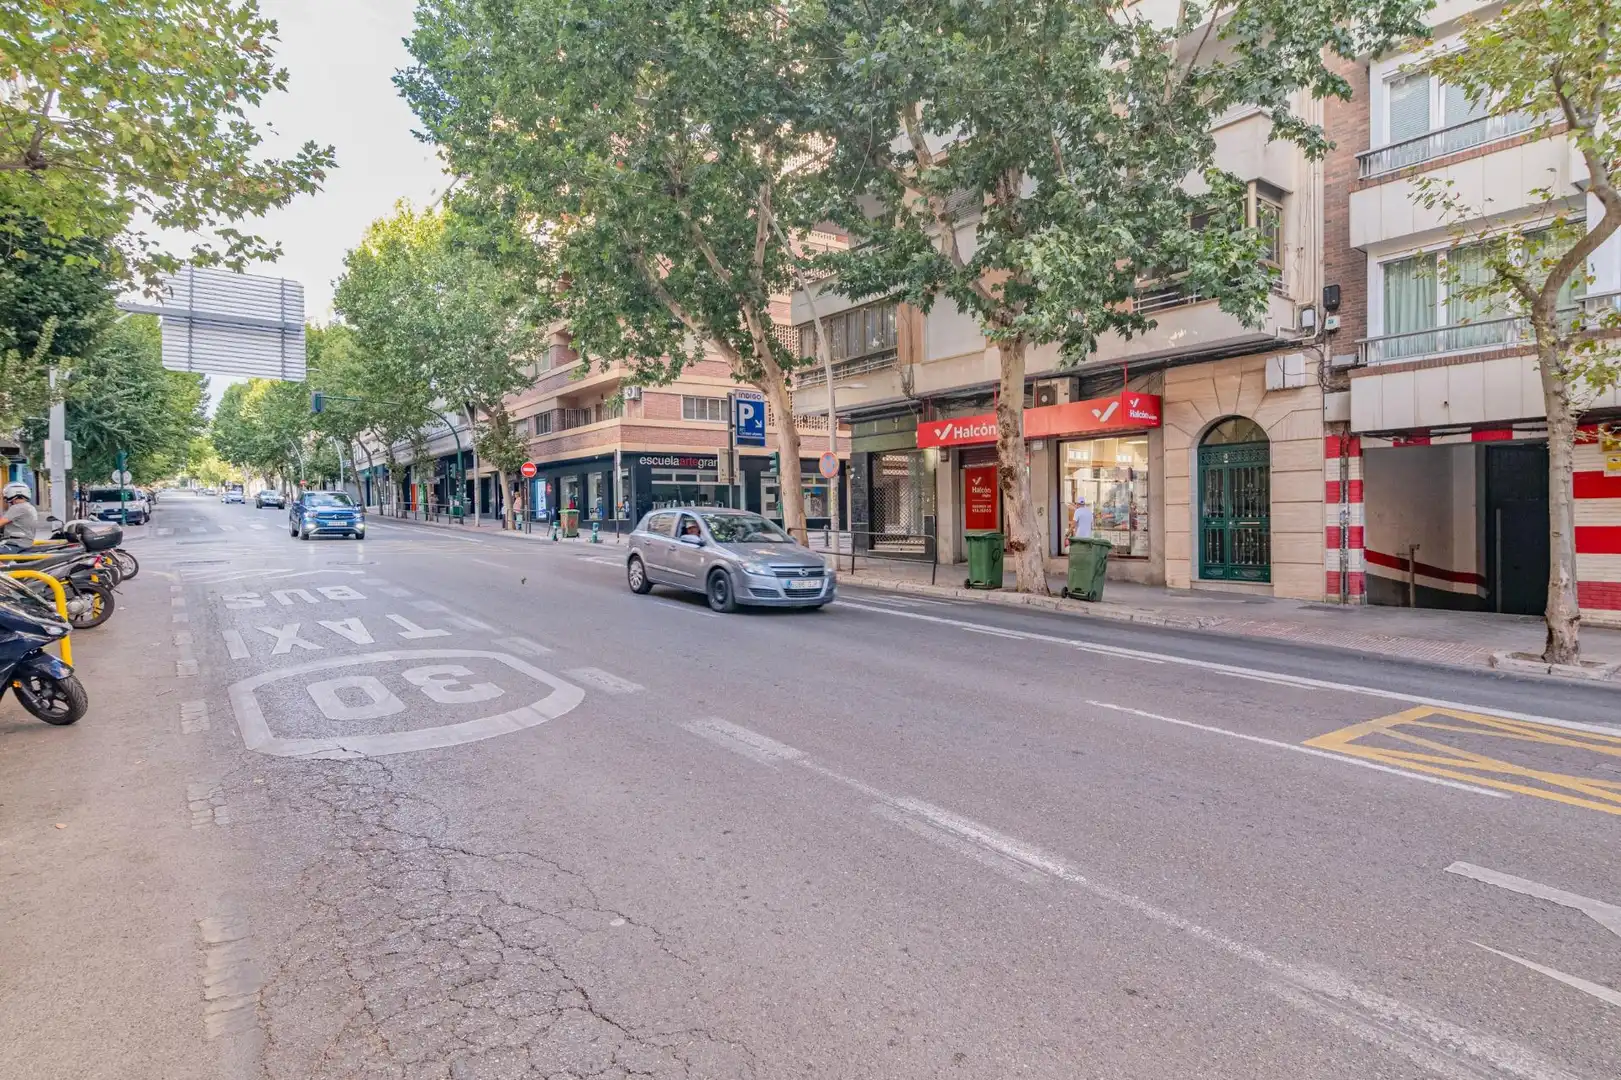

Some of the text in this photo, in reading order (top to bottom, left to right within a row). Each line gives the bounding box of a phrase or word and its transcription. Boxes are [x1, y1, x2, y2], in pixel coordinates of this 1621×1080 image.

[738, 403, 754, 427] P
[953, 422, 996, 439] Halcón
[222, 585, 367, 610] BUS
[221, 613, 453, 660] TAXI
[305, 664, 506, 721] 30
